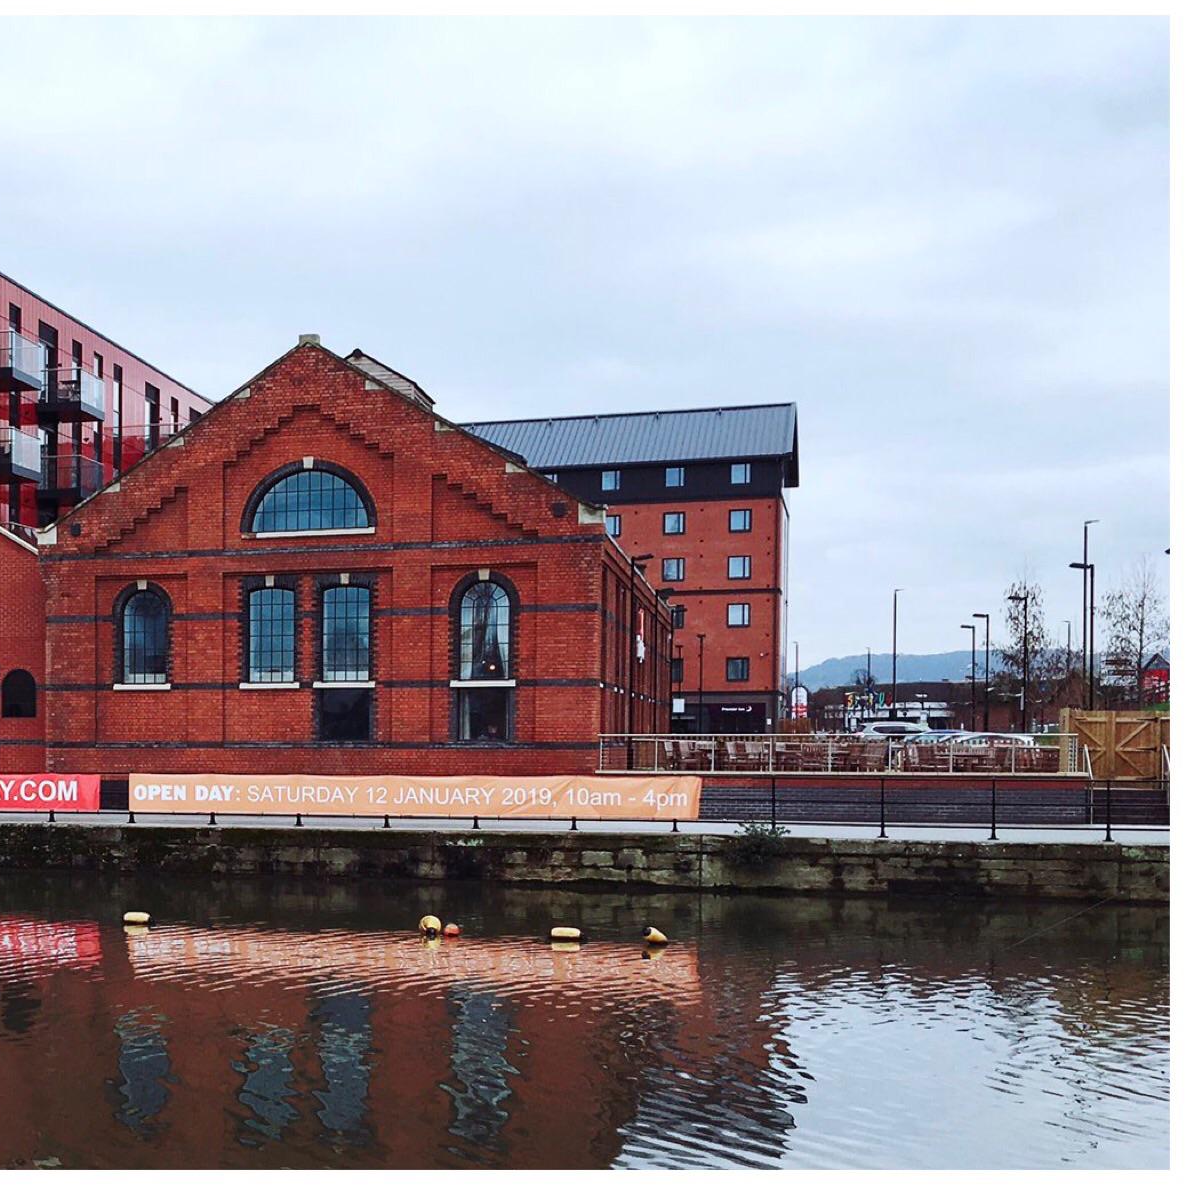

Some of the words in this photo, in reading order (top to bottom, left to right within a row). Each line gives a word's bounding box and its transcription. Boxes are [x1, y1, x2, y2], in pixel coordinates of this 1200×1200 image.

[134, 785, 186, 800] OPEN
[195, 785, 241, 801] DAY:
[247, 785, 359, 803] SATURDAY
[367, 787, 387, 804] 12
[393, 787, 495, 805] JANUARY
[502, 787, 557, 807] 2019,
[566, 788, 621, 806] 10am
[642, 789, 687, 810] 4pm
